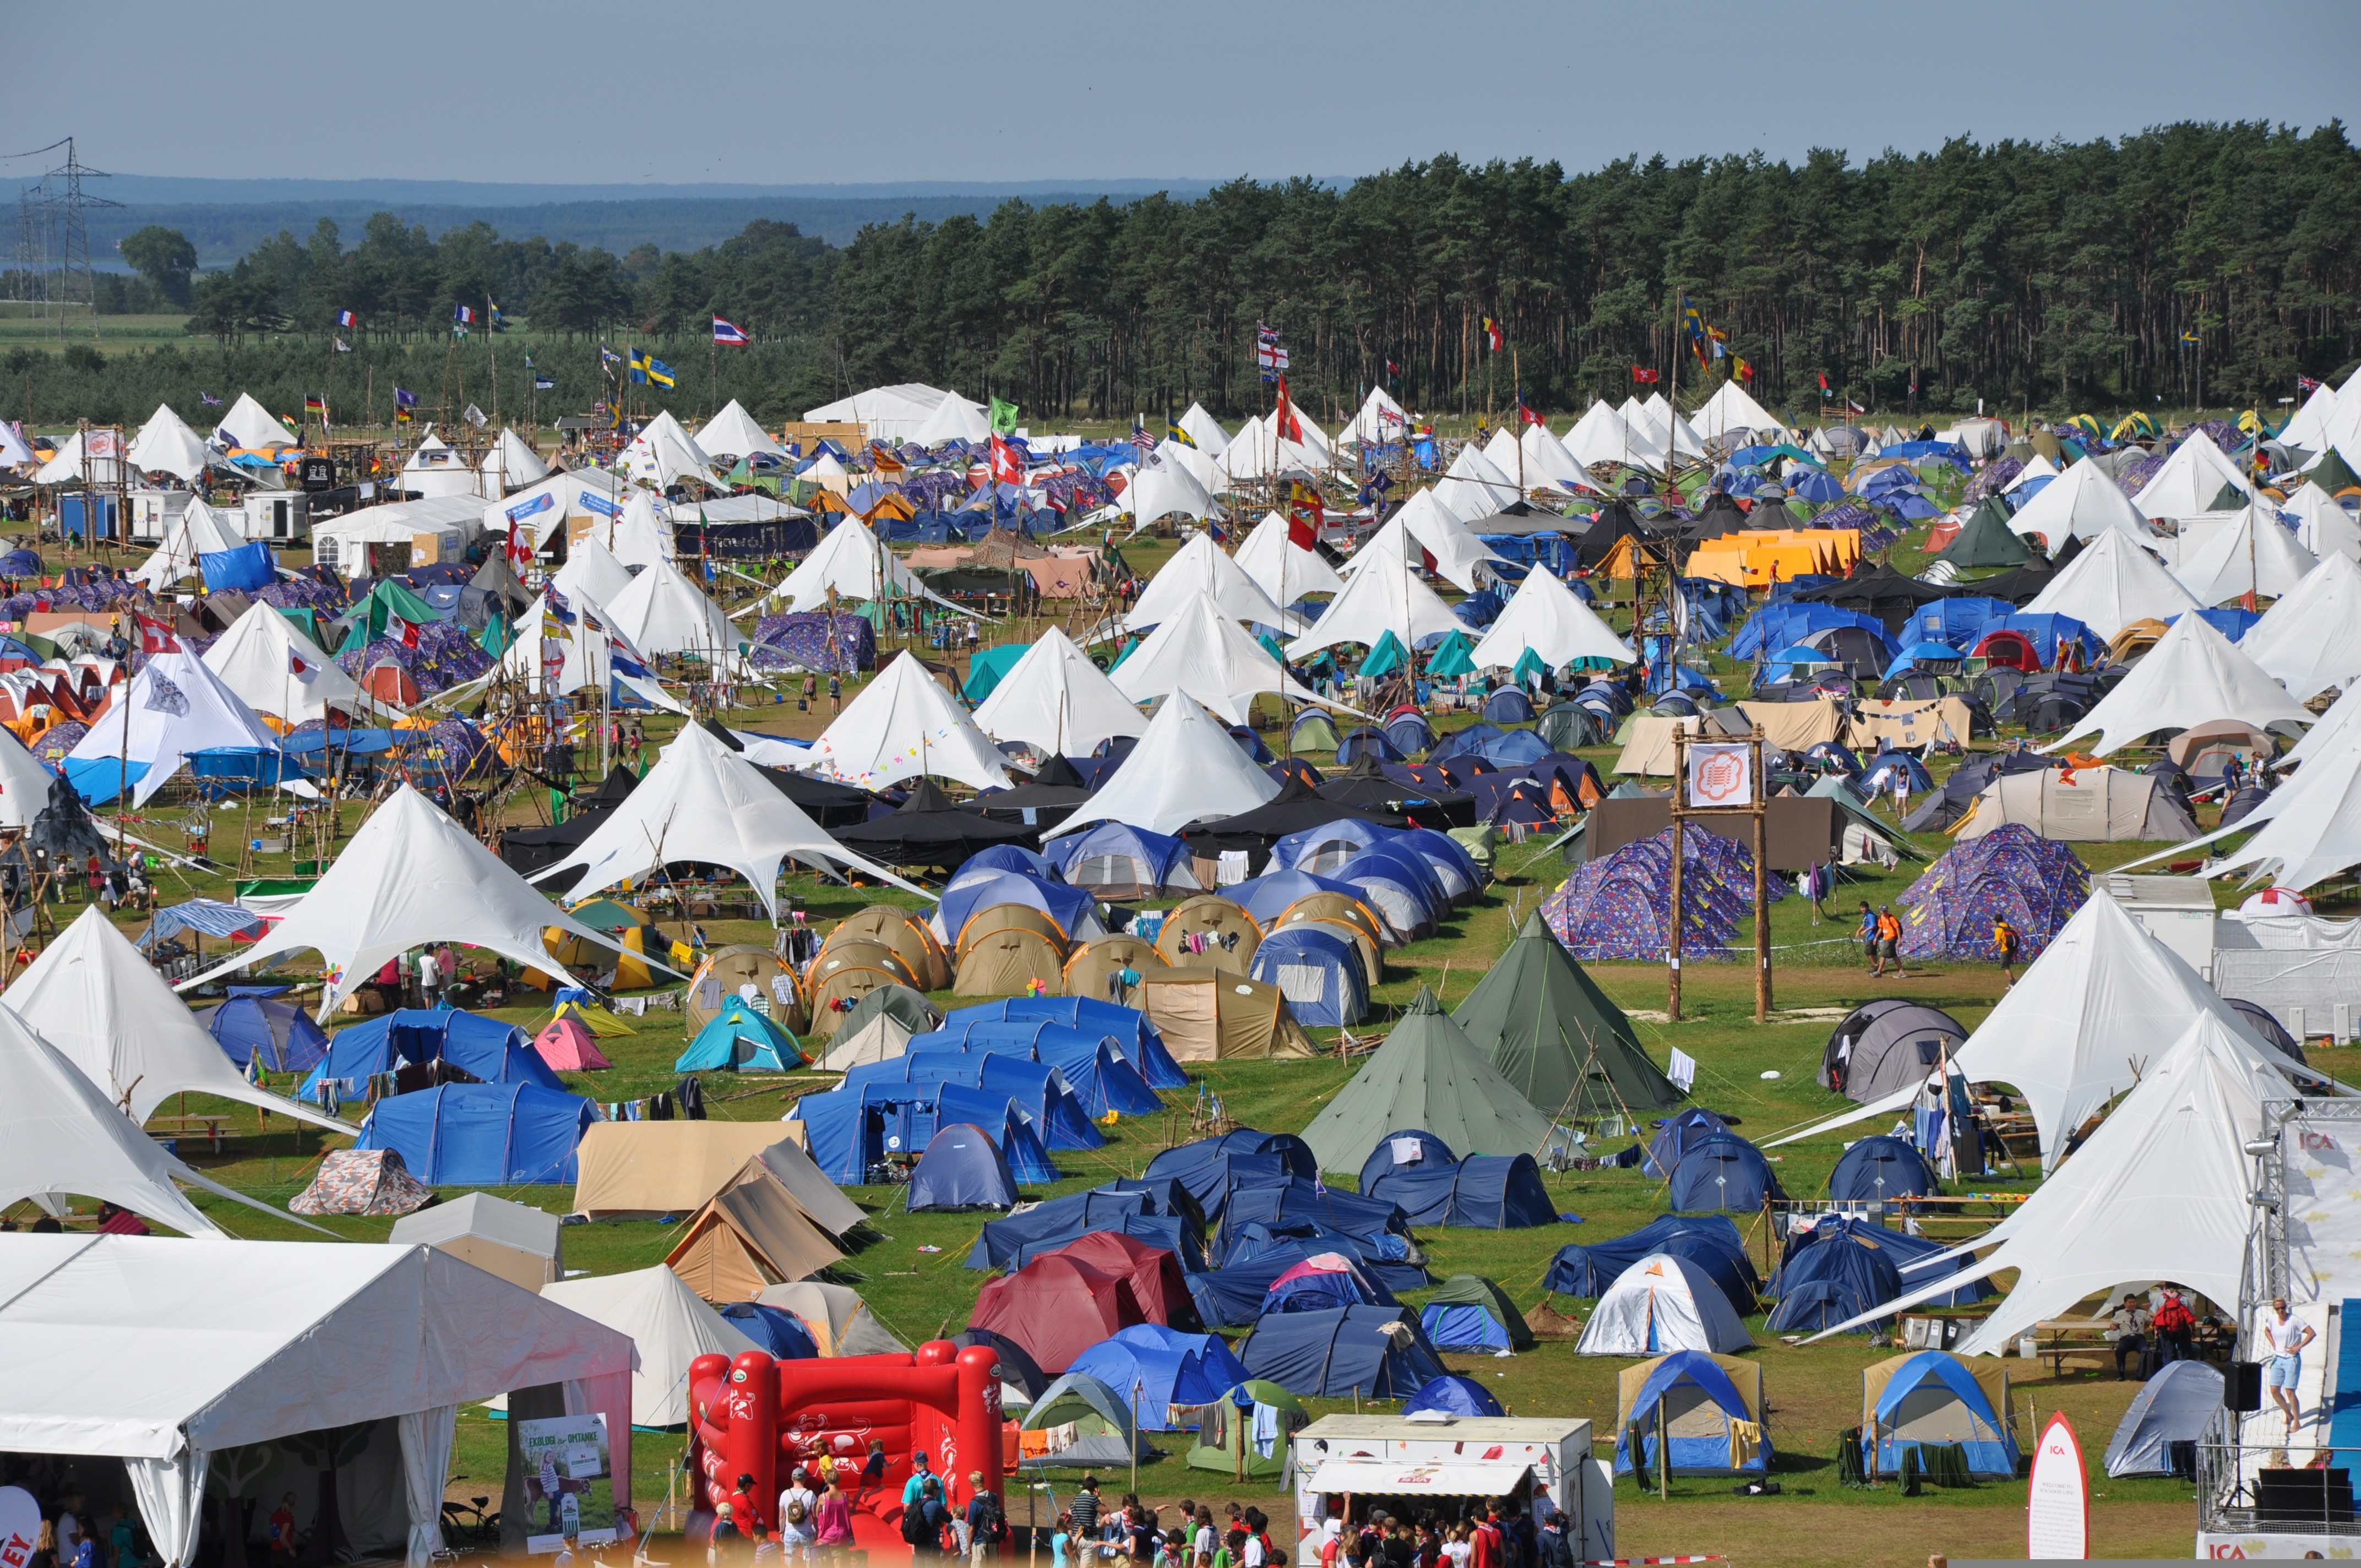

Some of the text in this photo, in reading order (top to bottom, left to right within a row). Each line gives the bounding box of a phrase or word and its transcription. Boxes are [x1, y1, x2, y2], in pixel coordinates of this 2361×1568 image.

[2299, 1133, 2335, 1151] ICA
[529, 1436, 556, 1448] EKOLOGI
[568, 1431, 598, 1444] OMTANKE
[2050, 1445, 2065, 1455] ICA
[2209, 1544, 2246, 1559] ICA
